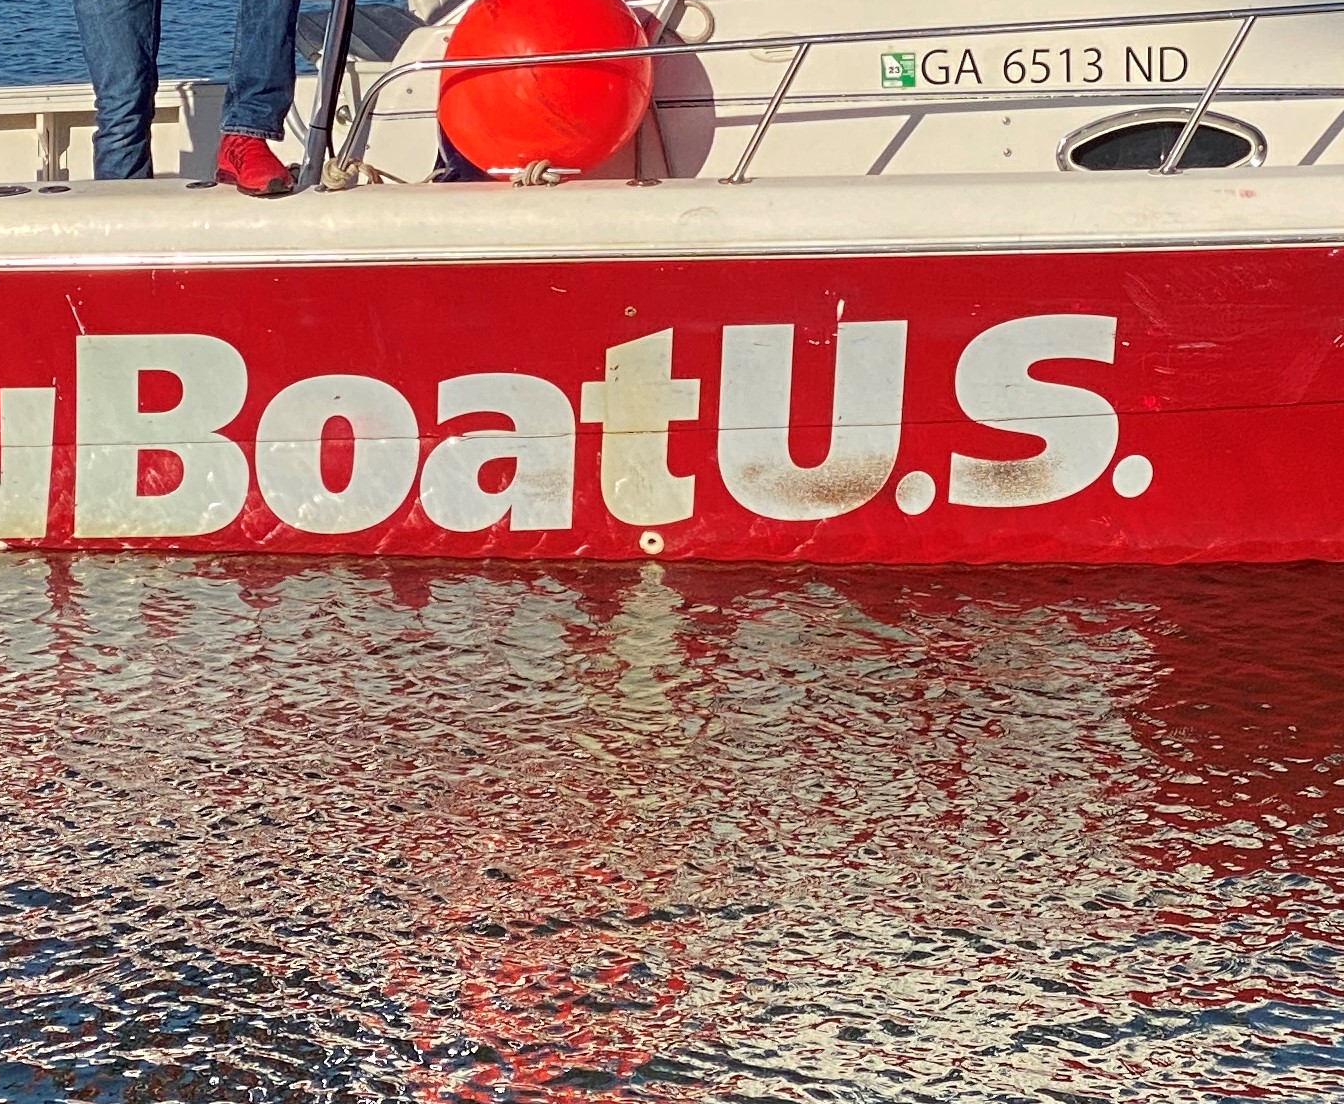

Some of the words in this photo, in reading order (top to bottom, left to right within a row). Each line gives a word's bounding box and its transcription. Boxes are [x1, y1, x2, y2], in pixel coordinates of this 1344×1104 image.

[888, 66, 901, 74] 23
[920, 48, 983, 85] GA
[1003, 47, 1103, 84] 6513
[1125, 46, 1188, 83] ND
